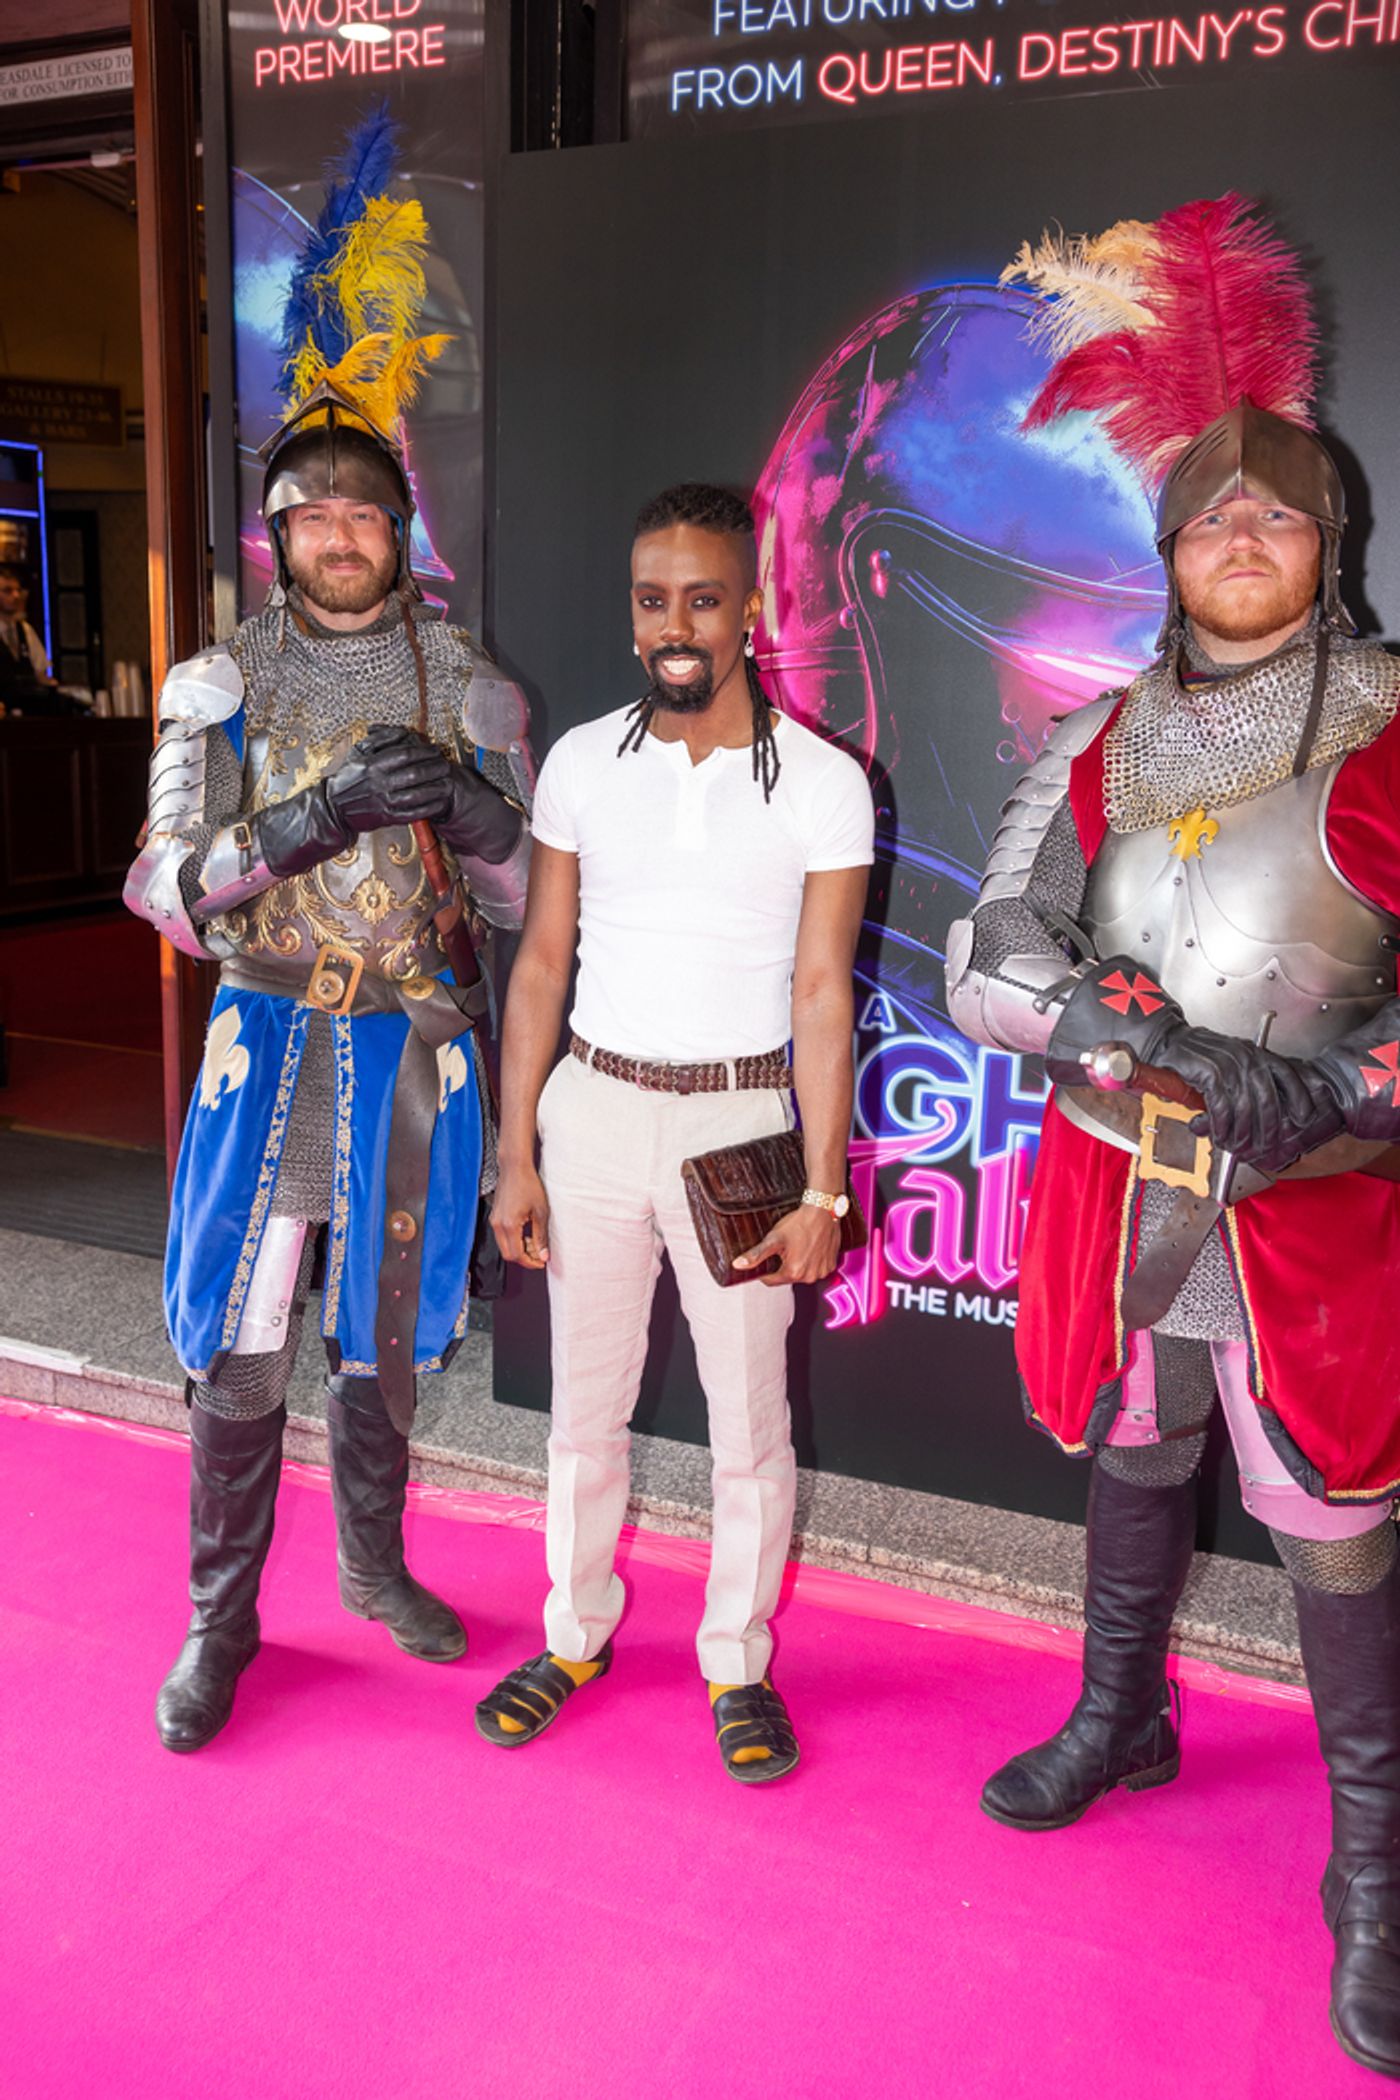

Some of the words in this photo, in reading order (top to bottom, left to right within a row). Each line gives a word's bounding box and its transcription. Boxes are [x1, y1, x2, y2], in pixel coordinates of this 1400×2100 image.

[713, 0, 977, 36] FEATUR
[0, 66, 51, 85] EASDALE
[57, 57, 113, 77] LICENSED
[115, 53, 132, 68] TO
[254, 24, 446, 88] PREMIERE
[671, 58, 803, 112] FROM
[817, 37, 1003, 104] QUEEN,
[1017, 6, 1287, 81] DESTINY'S
[1304, 0, 1400, 49] CHI
[1, 87, 19, 101] OR
[22, 75, 103, 98] CONSUMPTION
[858, 993, 898, 1033] A
[884, 1279, 948, 1317] THE
